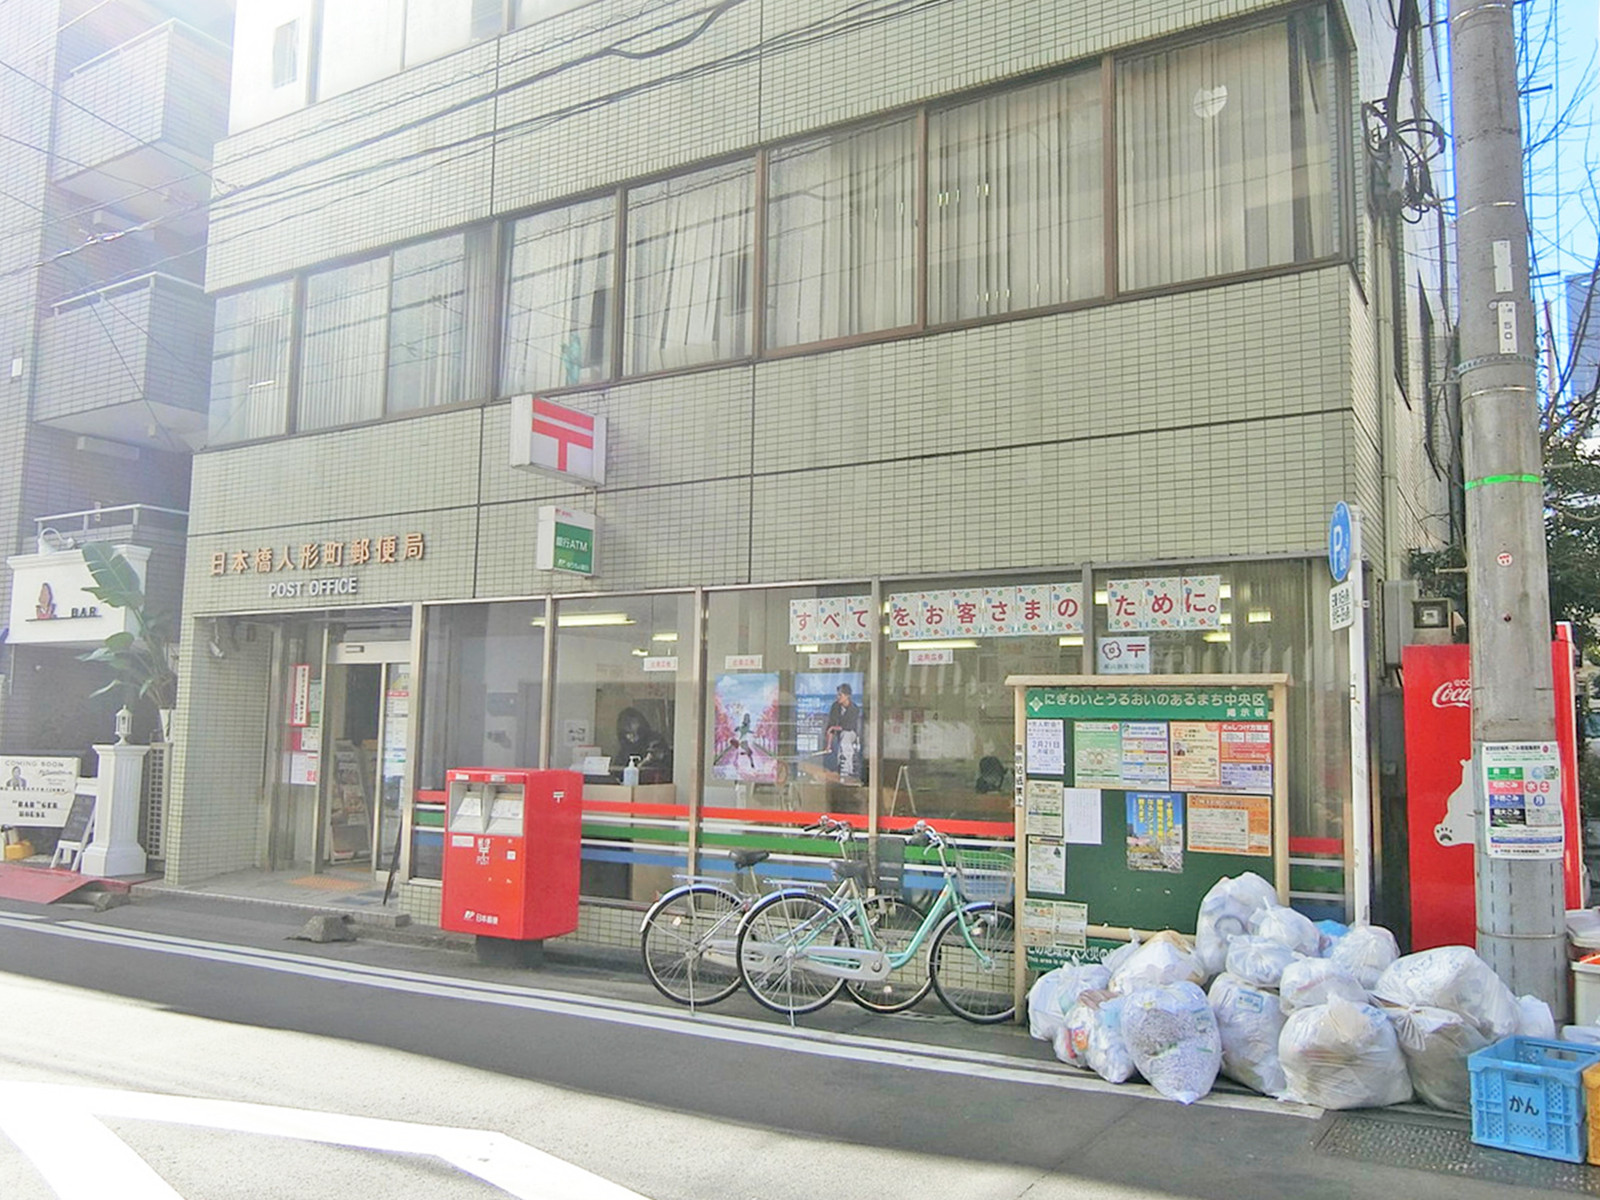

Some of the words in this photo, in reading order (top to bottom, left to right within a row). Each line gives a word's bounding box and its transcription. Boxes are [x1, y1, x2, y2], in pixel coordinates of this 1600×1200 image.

[210, 532, 425, 576] 日本橋人形町郵便局
[1334, 525, 1343, 576] P
[269, 581, 304, 598] POST
[309, 577, 358, 597] OFFICE
[71, 606, 97, 618] BAR
[796, 608, 868, 631] すべて
[892, 597, 1079, 627] を、お客さまの
[1114, 590, 1218, 617] ために。
[1044, 692, 1265, 706] にぎわいとうるおいのあるまち中央区
[1508, 1095, 1540, 1116] かん
